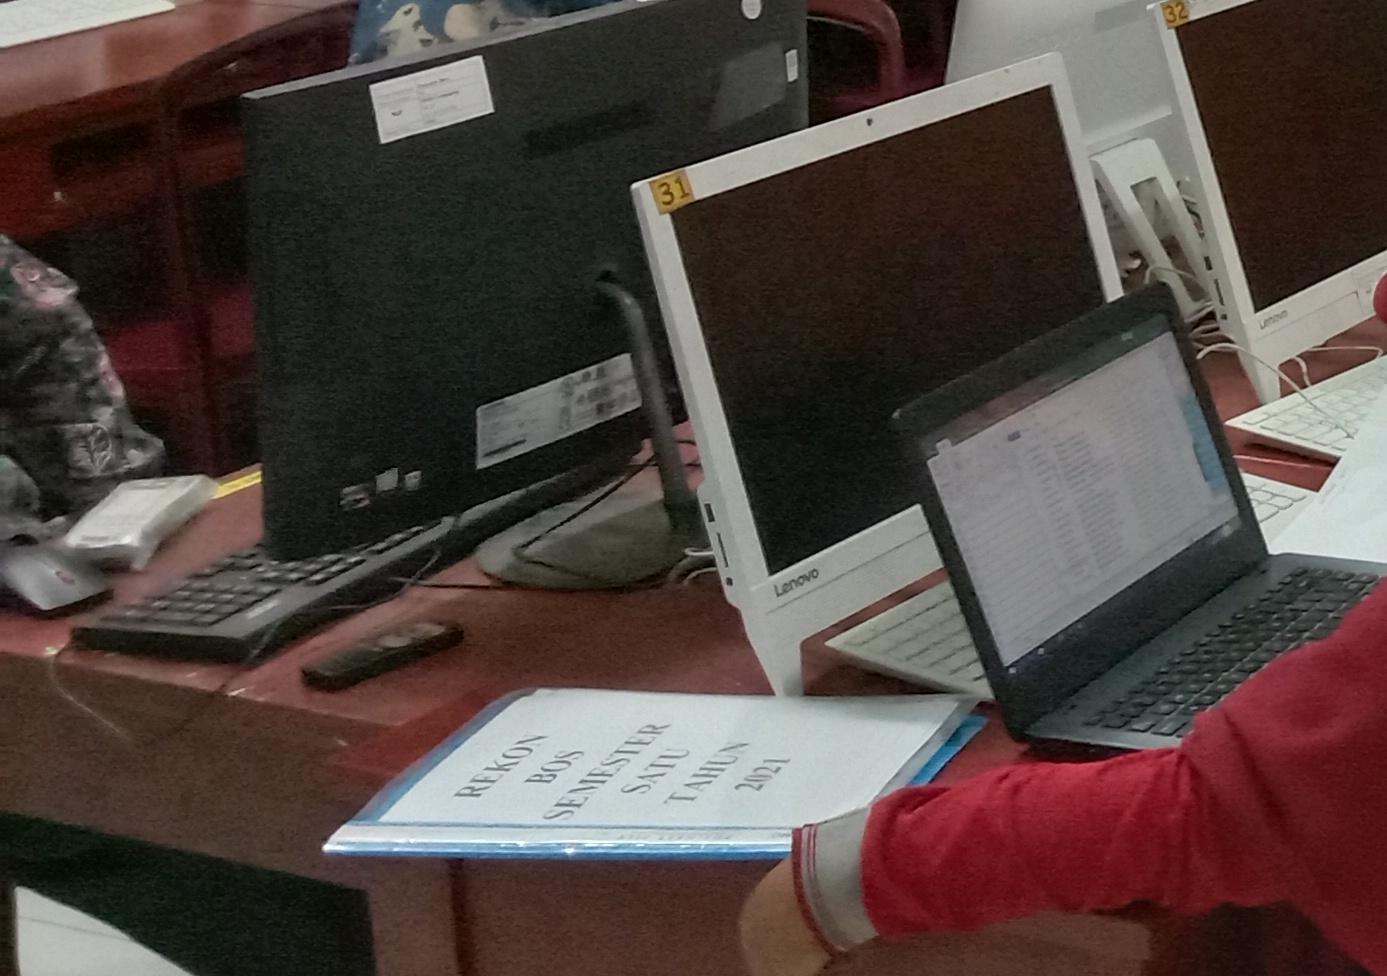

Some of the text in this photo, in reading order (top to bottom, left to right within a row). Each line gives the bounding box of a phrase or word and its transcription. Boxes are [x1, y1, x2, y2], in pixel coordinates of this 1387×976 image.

[1163, 1, 1189, 23] 32
[657, 175, 690, 206] 31
[773, 568, 819, 598] Lenovo
[454, 734, 549, 799] REKON
[524, 749, 585, 785] BOS
[542, 723, 672, 821] SEMESTER
[620, 747, 691, 795] SATU
[663, 741, 750, 805] TAHUN
[733, 757, 791, 792] 2021
